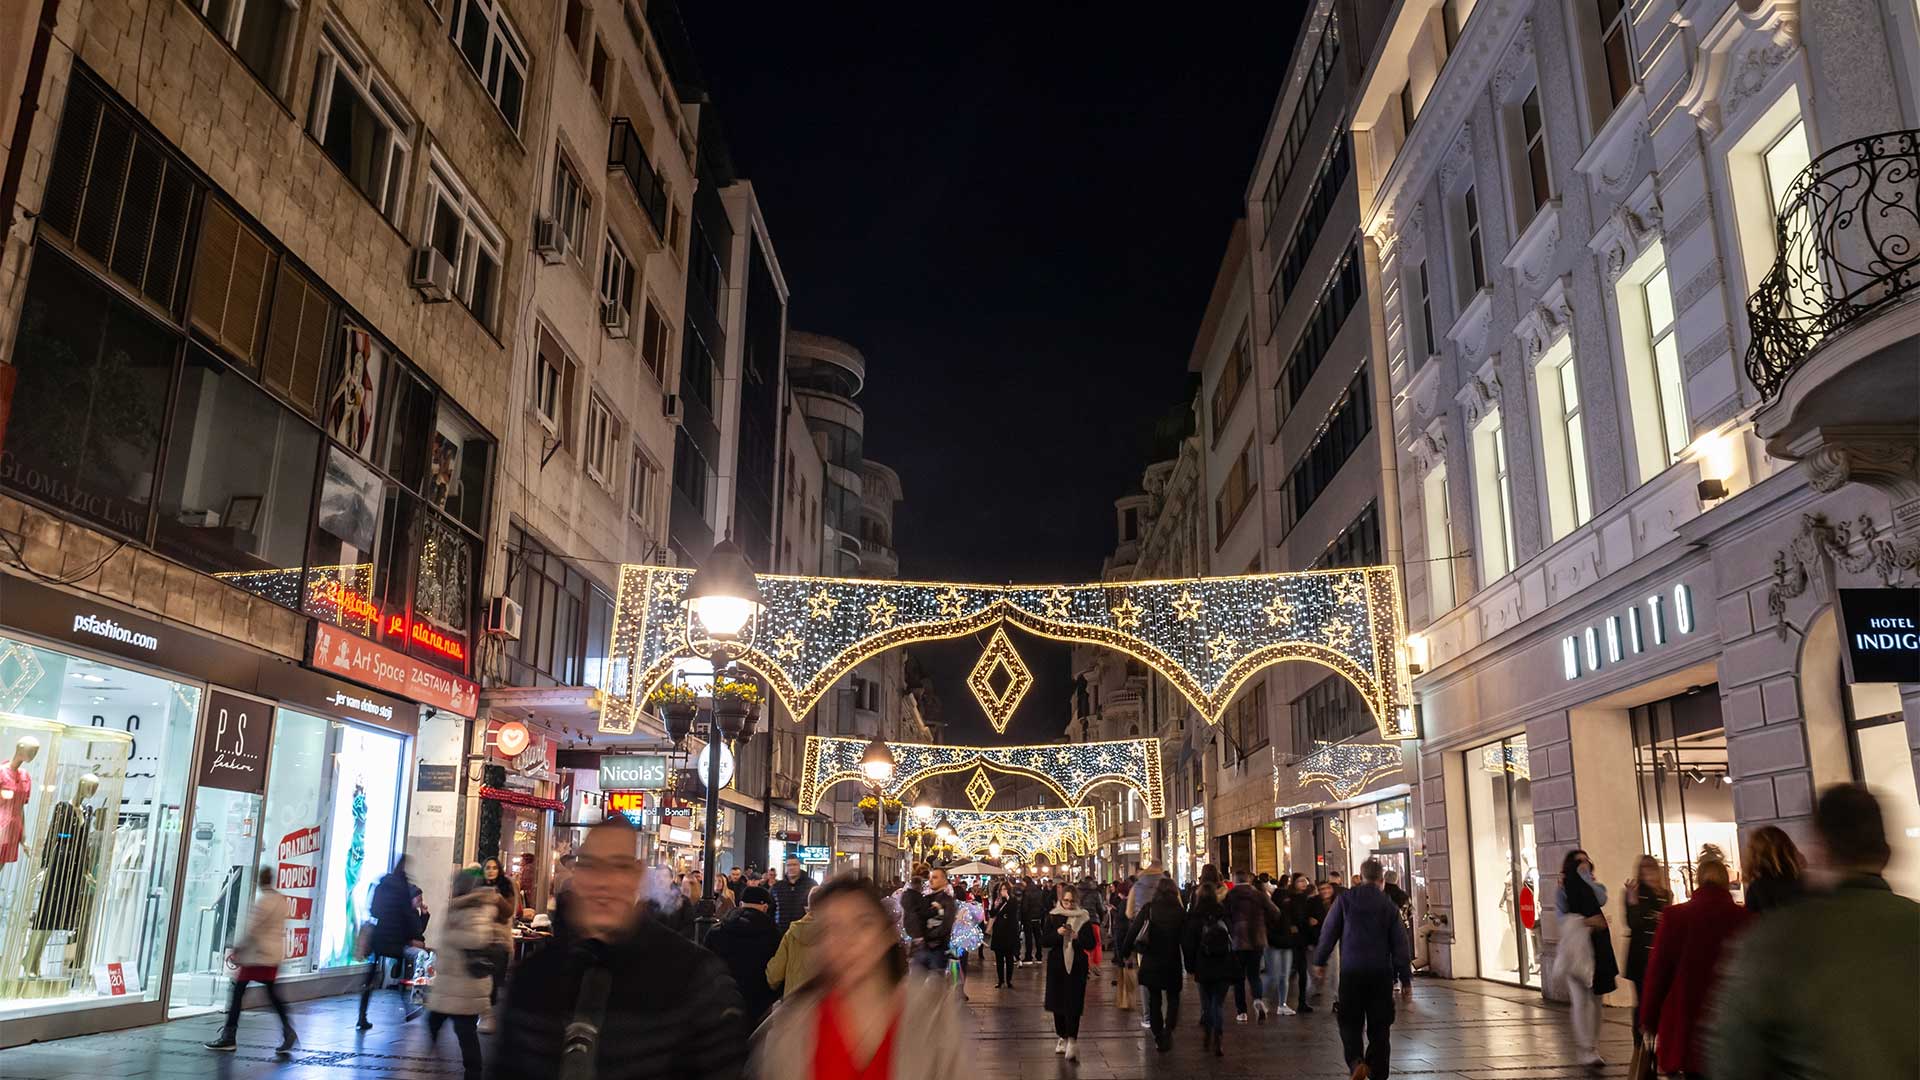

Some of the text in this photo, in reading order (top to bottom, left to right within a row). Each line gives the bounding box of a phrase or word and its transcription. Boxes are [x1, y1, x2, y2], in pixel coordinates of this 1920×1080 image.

[103, 498, 145, 532] LAW
[73, 614, 158, 650] psfashion.com
[1562, 584, 1692, 681] MOHITO
[1870, 618, 1915, 628] HOTEL
[1856, 633, 1920, 649] INDIG
[352, 647, 371, 672] Art
[372, 653, 406, 682] Space
[411, 668, 451, 694] ZASTAVA
[664, 807, 691, 816] Bonatti
[280, 829, 320, 860] PRAZNIČNI
[280, 867, 314, 888] POPUST
